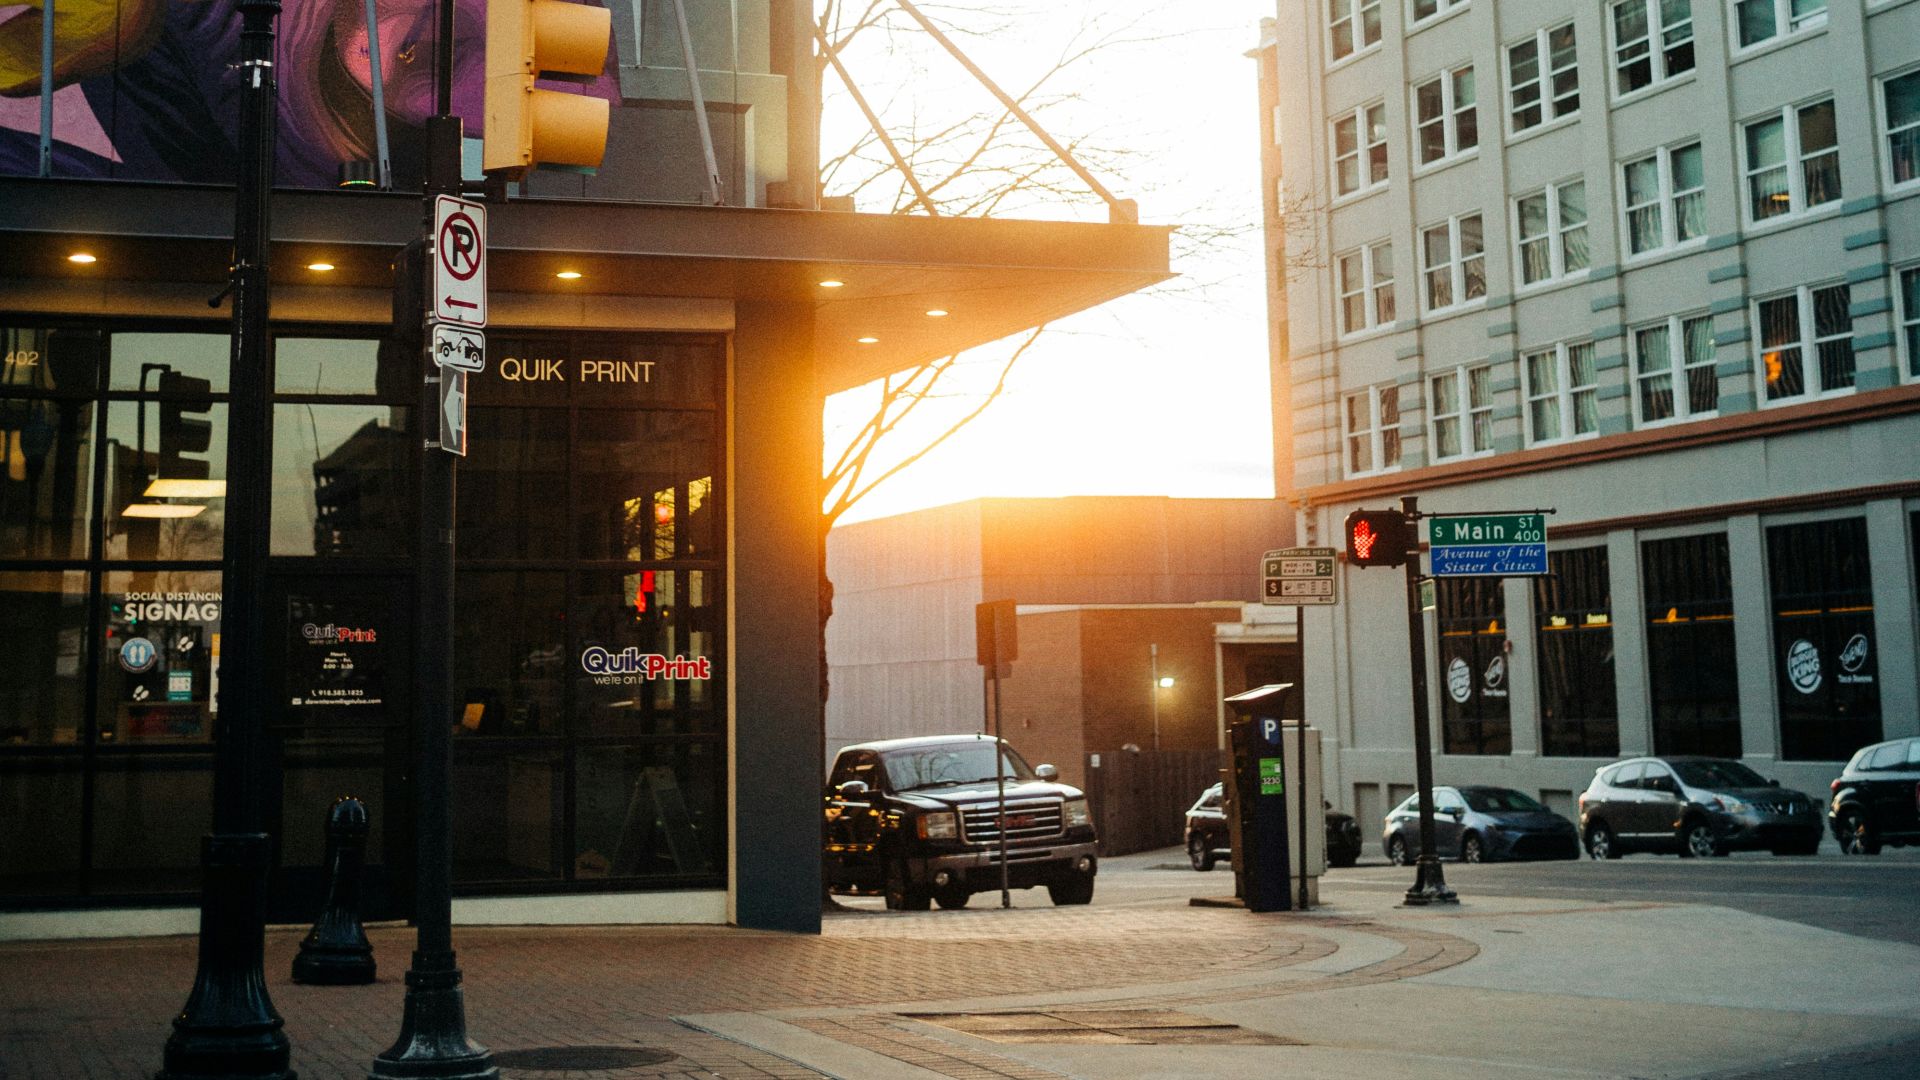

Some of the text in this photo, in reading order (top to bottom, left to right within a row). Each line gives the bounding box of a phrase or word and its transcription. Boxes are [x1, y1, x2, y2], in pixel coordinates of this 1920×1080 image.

[452, 223, 474, 267] P
[5, 351, 39, 366] 402
[500, 358, 655, 383] QUIK PRINT
[1435, 521, 1504, 541] S Main
[1518, 517, 1533, 528] ST
[1514, 530, 1541, 542] 400
[1436, 546, 1541, 562] Avenue of the
[1270, 563, 1278, 573] P
[1441, 559, 1536, 574] Sister Cities
[125, 592, 222, 601] SOCIAL DISTANCIN
[124, 602, 222, 621] SIGNAG
[303, 623, 377, 642] QuikPrint
[582, 646, 711, 680] QuikPrint
[1792, 658, 1820, 679] KING
[623, 675, 637, 685] on
[1264, 719, 1276, 740] P
